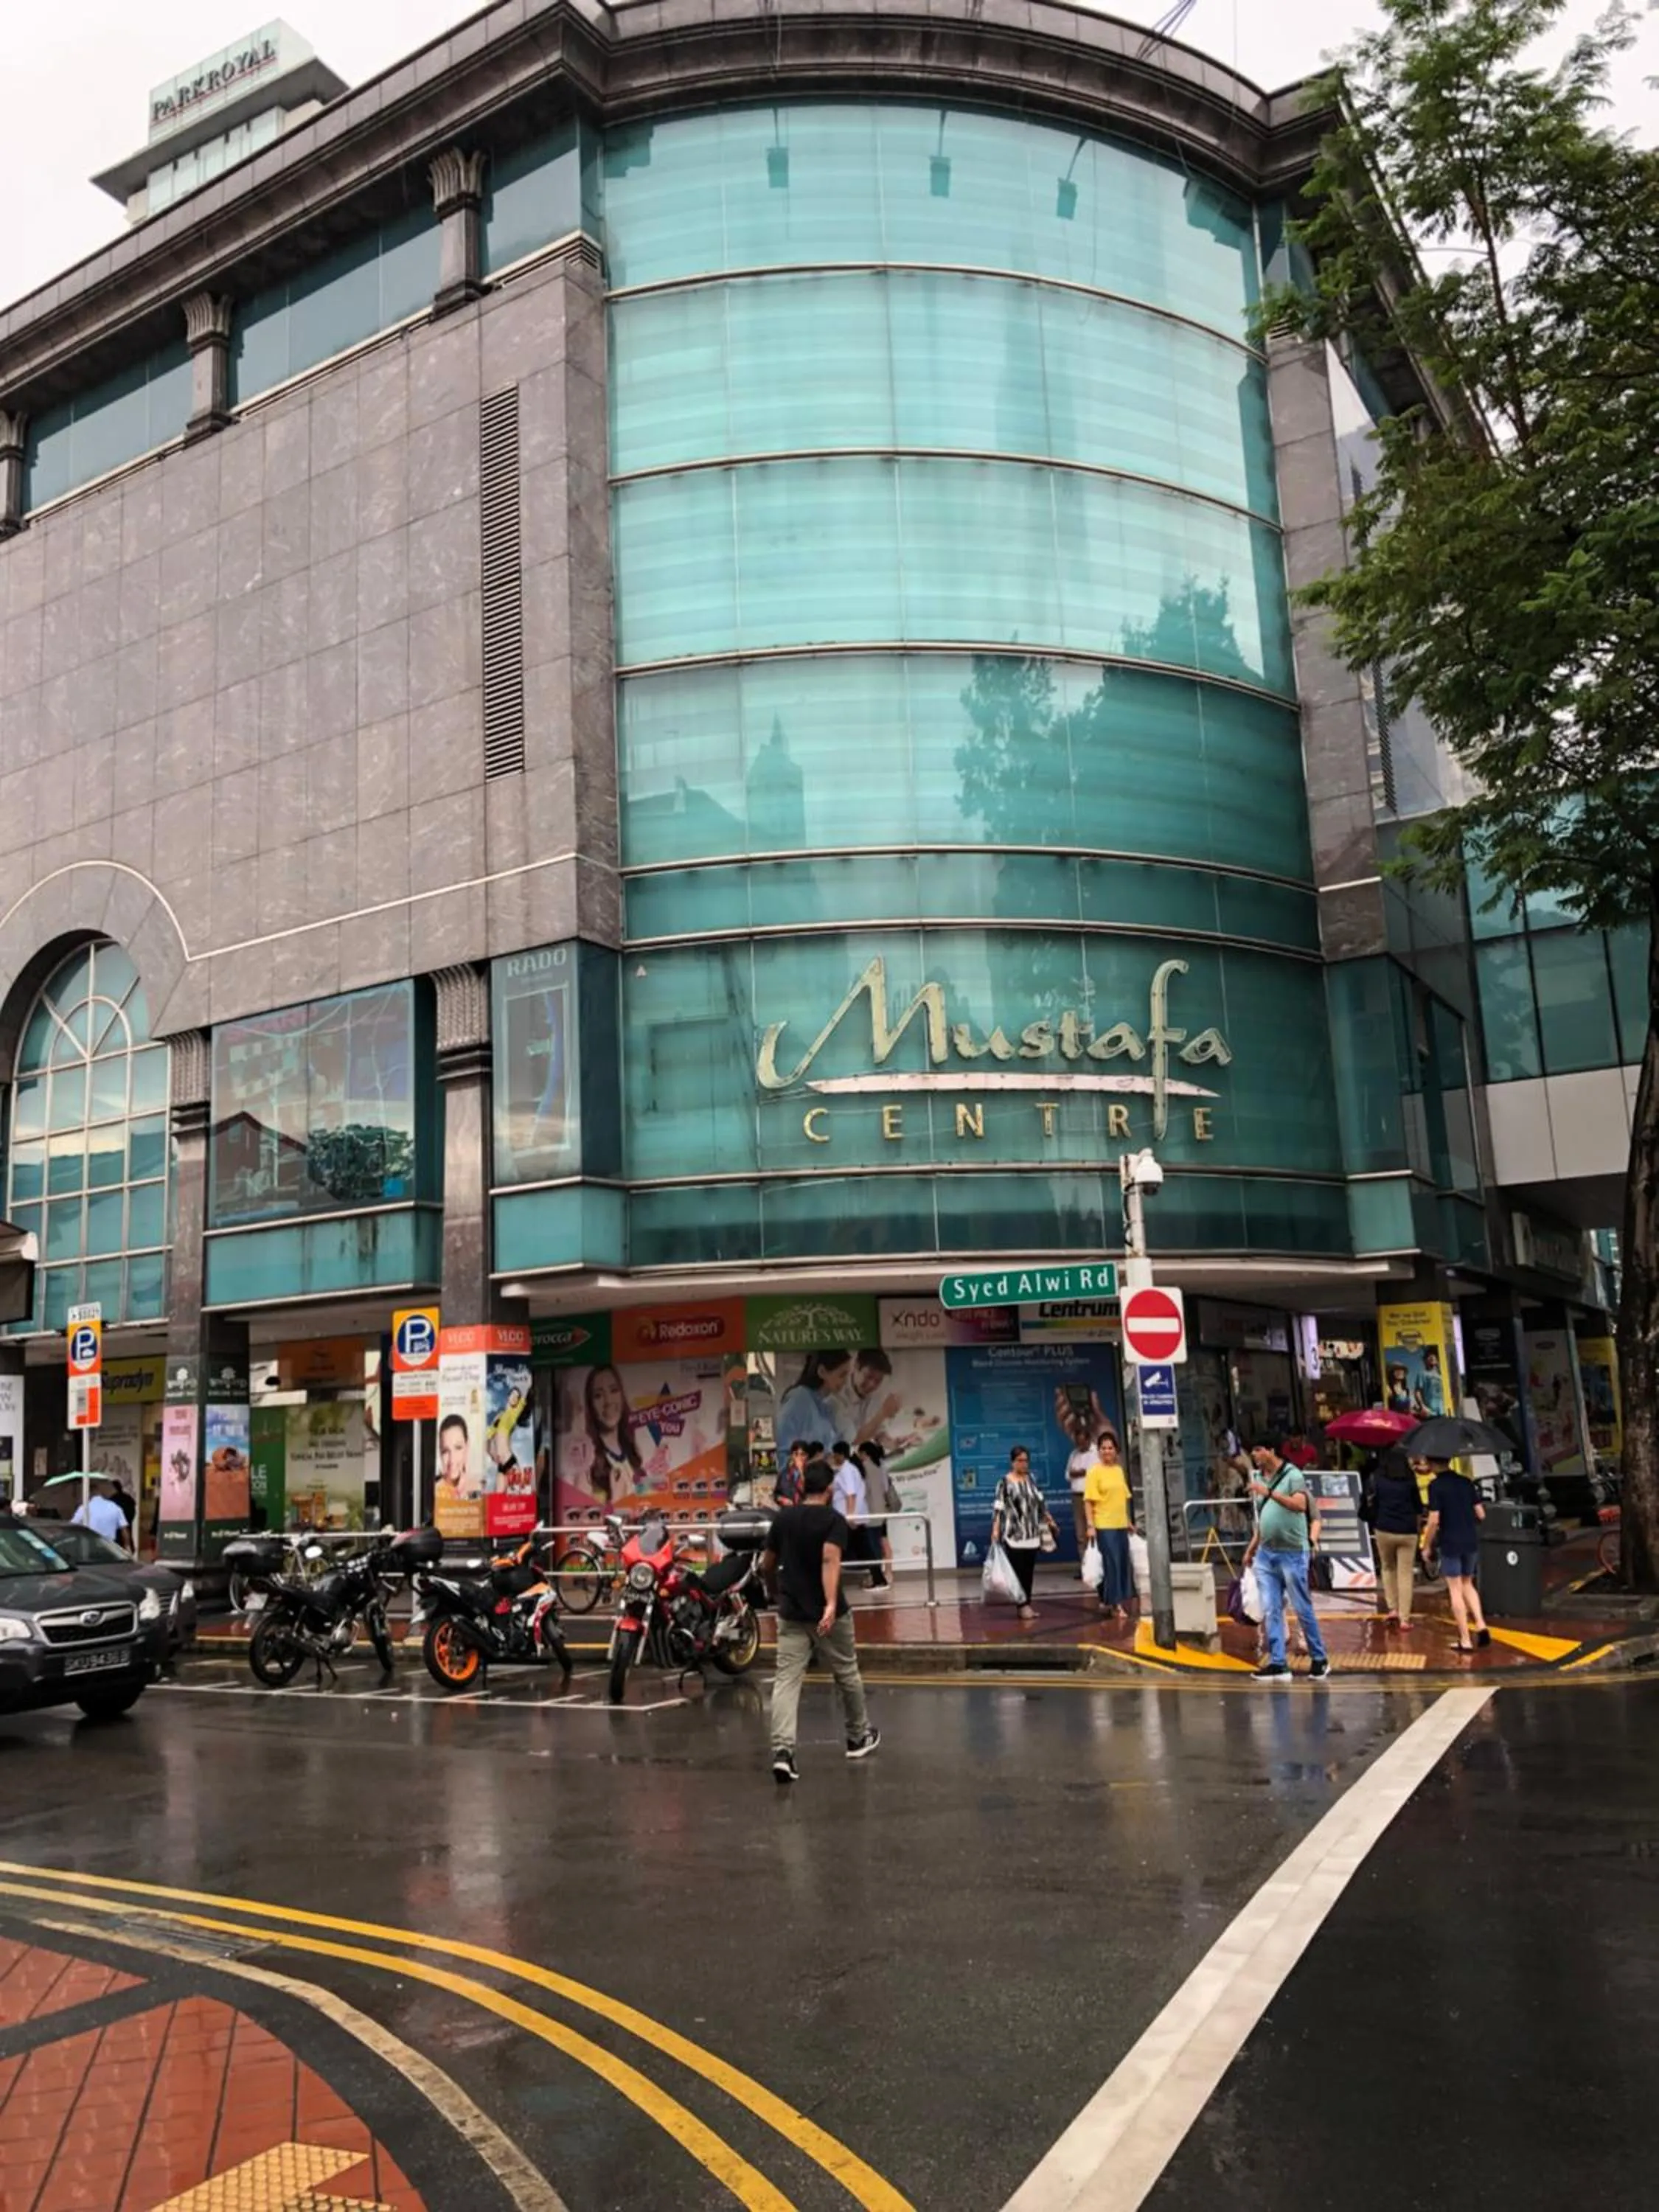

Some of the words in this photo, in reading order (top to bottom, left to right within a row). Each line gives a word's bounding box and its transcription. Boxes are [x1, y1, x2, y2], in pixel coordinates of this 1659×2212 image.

[153, 39, 276, 121] PARKROYAL
[507, 947, 567, 978] RADO
[756, 957, 1233, 1140] Mustafa
[802, 1102, 1214, 1143] CENTRE
[953, 1275, 1008, 1302] Syed
[1018, 1270, 1069, 1295] Alwi
[1079, 1267, 1109, 1289] Rd
[1039, 1300, 1120, 1318] Centrum
[659, 1321, 719, 1340] Redoxon
[834, 1326, 866, 1343] WAY
